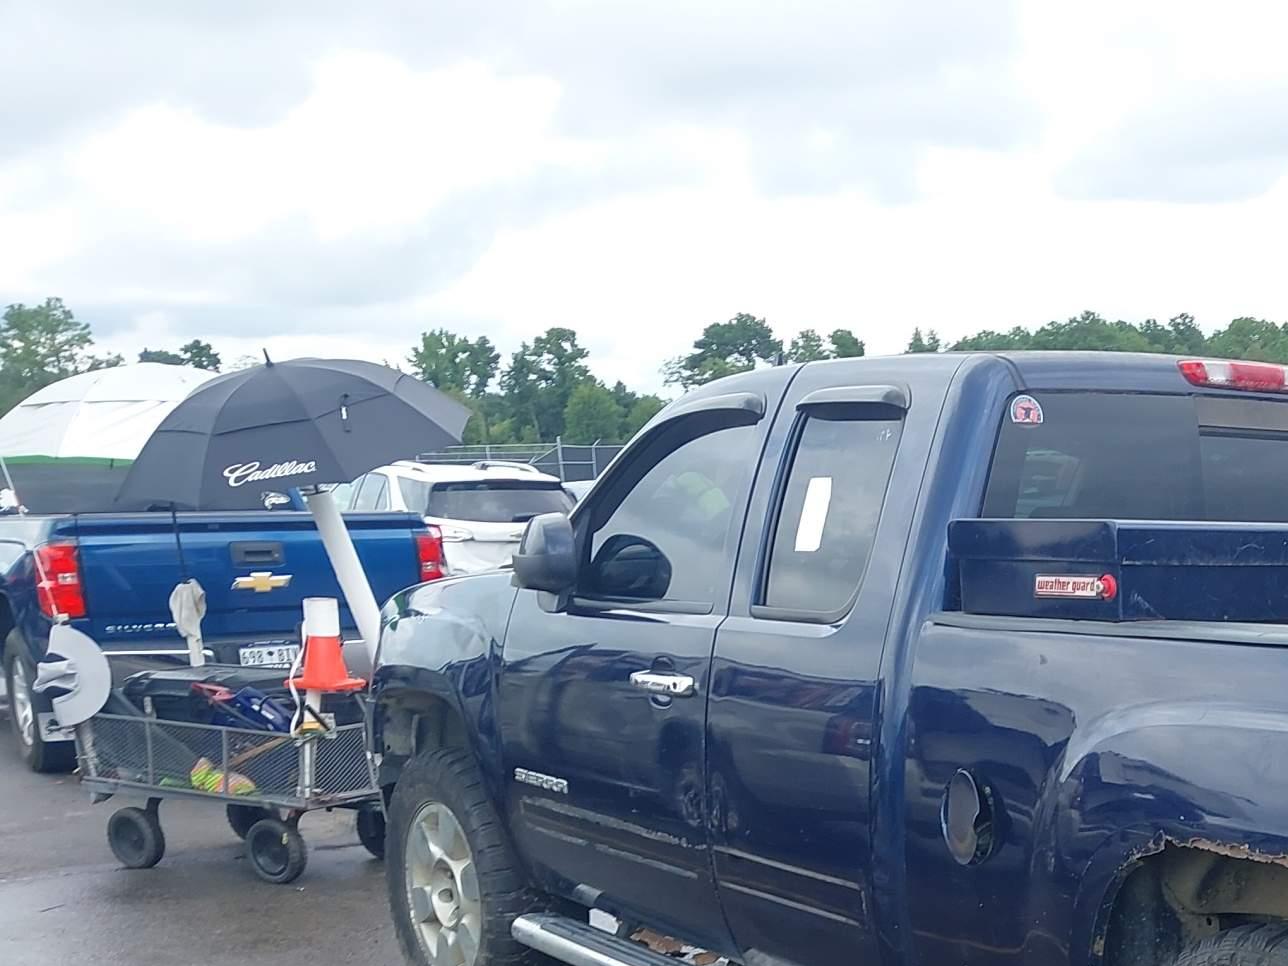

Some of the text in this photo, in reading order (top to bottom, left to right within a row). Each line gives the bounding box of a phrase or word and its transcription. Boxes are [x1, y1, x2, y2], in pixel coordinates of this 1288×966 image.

[222, 461, 316, 487] Cadillac
[1037, 578, 1095, 592] weather guard
[104, 622, 177, 634] SILVERA
[514, 767, 569, 794] SIERRA
